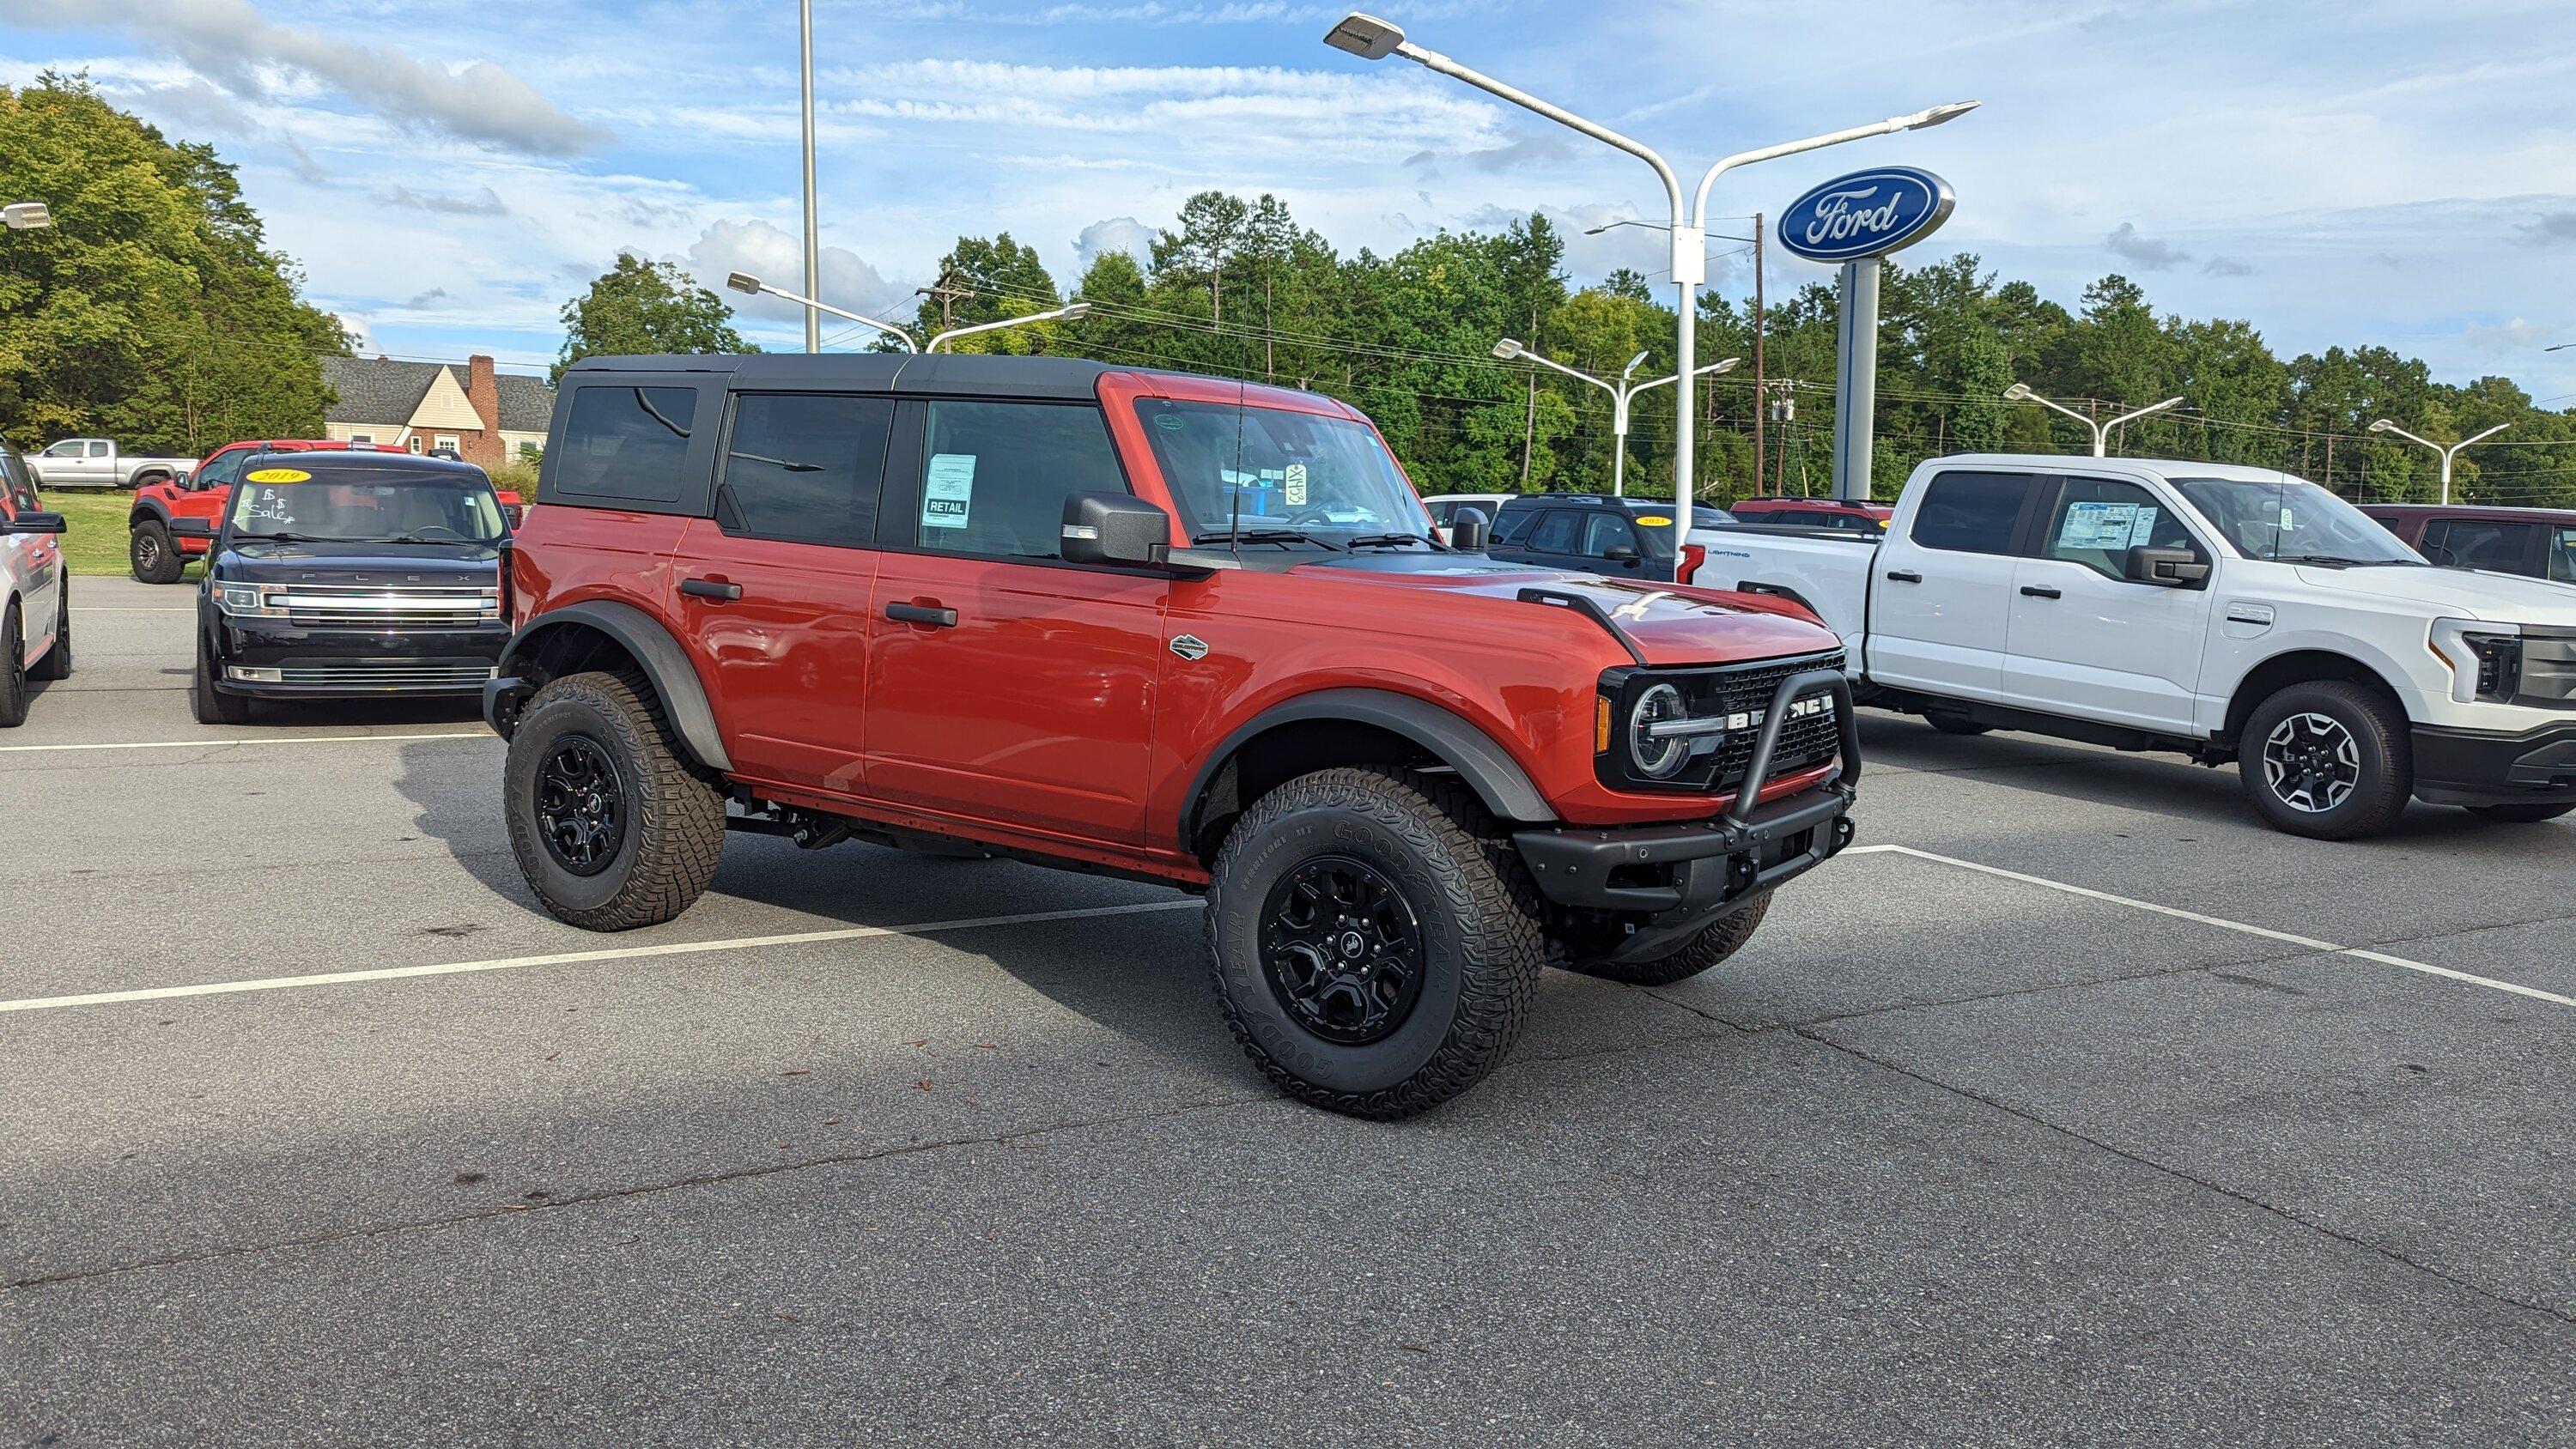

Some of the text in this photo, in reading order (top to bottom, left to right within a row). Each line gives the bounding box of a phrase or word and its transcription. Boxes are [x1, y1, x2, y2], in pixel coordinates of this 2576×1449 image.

[1806, 186, 1902, 245] Ford
[258, 471, 300, 481] 2019
[1288, 469, 1304, 503] X1453
[248, 504, 286, 520] Sale
[930, 500, 963, 513] RETAIL
[1707, 549, 1751, 558] LIGHTNING
[302, 573, 471, 582] FLEX
[1728, 694, 1834, 730] BRNCO
